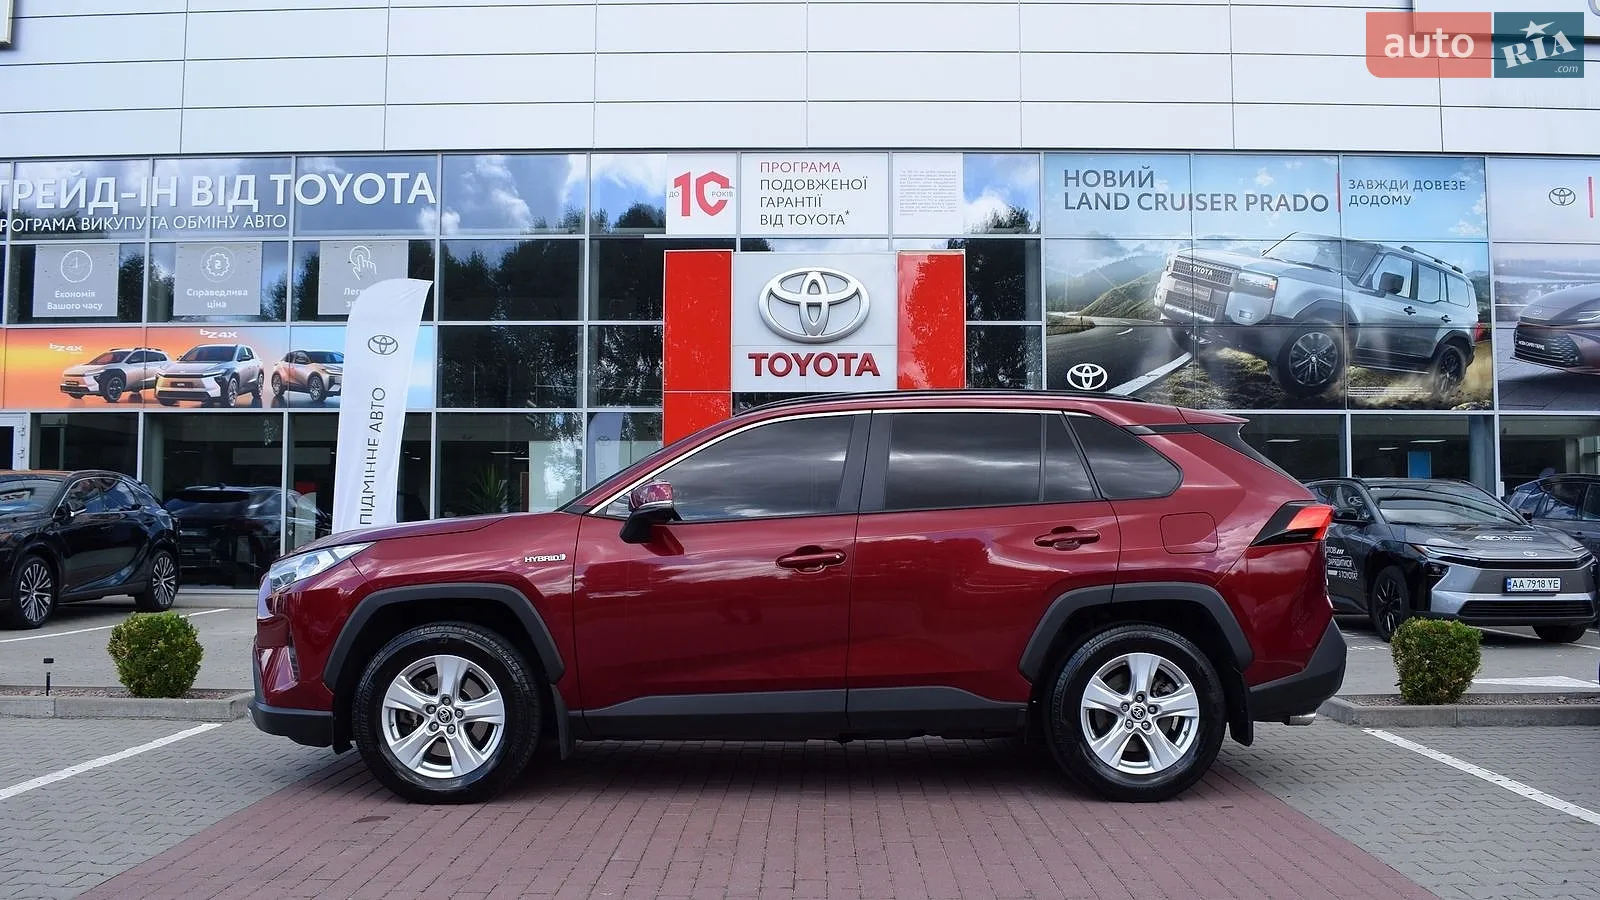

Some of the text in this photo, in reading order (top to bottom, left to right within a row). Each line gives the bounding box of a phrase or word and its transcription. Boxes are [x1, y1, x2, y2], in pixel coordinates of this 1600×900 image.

[760, 161, 842, 173] ПРОГРАМА
[1063, 165, 1155, 188] НОВИЙ
[760, 176, 868, 193] ПОДОВЖЕНОЇ
[1348, 179, 1466, 192] ЗАВЖДИ ДОВЕЗЕ
[191, 174, 259, 213] ВІД
[269, 172, 437, 206] TOYOTA
[760, 193, 823, 208] ГАРАНТІЇ
[1063, 192, 1329, 213] LAND CRUISER PRADO
[1348, 195, 1412, 207] ДОДОМУ
[81, 216, 147, 231] ВИКУПУ
[151, 215, 169, 230] ТА
[173, 214, 239, 230] ОБМІНУ
[243, 214, 287, 228] АВТО
[760, 213, 784, 228] ВІД
[1189, 265, 1214, 277] TOYOTA
[186, 288, 248, 299] Справедлива
[47, 301, 103, 312] Вашого часу
[206, 300, 227, 309] ціна
[748, 352, 880, 377] TOYOTA
[359, 387, 386, 525] ПІДМІННЕ АВТО
[524, 555, 560, 563] HYBRID
[1512, 579, 1559, 589] AA 7918 YE
